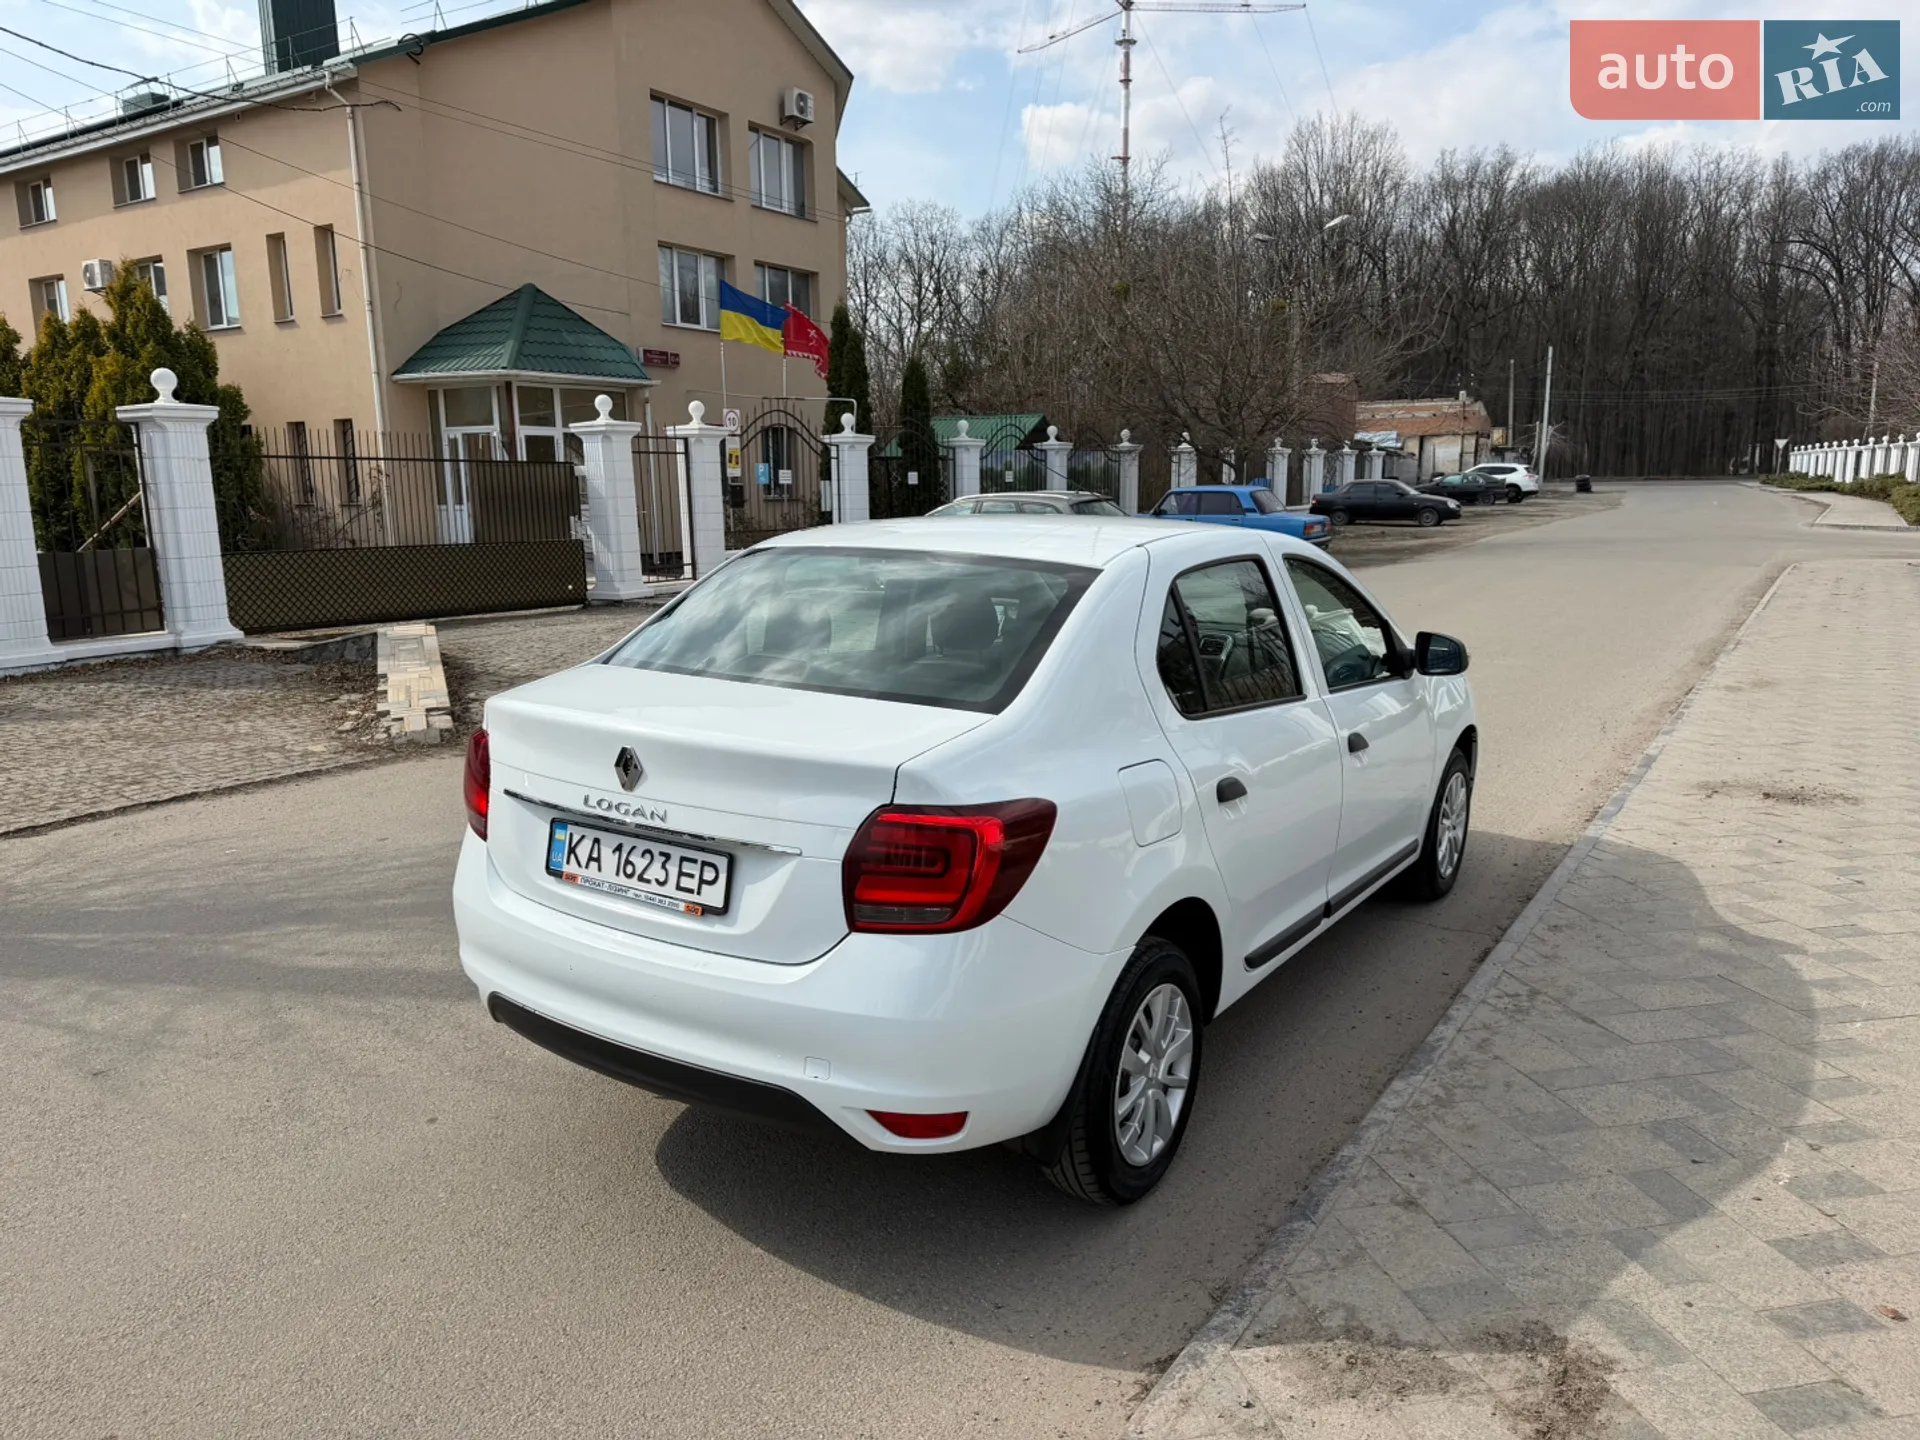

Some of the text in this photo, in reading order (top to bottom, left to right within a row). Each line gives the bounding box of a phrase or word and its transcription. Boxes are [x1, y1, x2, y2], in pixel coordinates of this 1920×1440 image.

[727, 416, 738, 427] 10
[583, 794, 667, 824] LOGAN
[552, 851, 563, 863] UA
[612, 842, 672, 887] 1623
